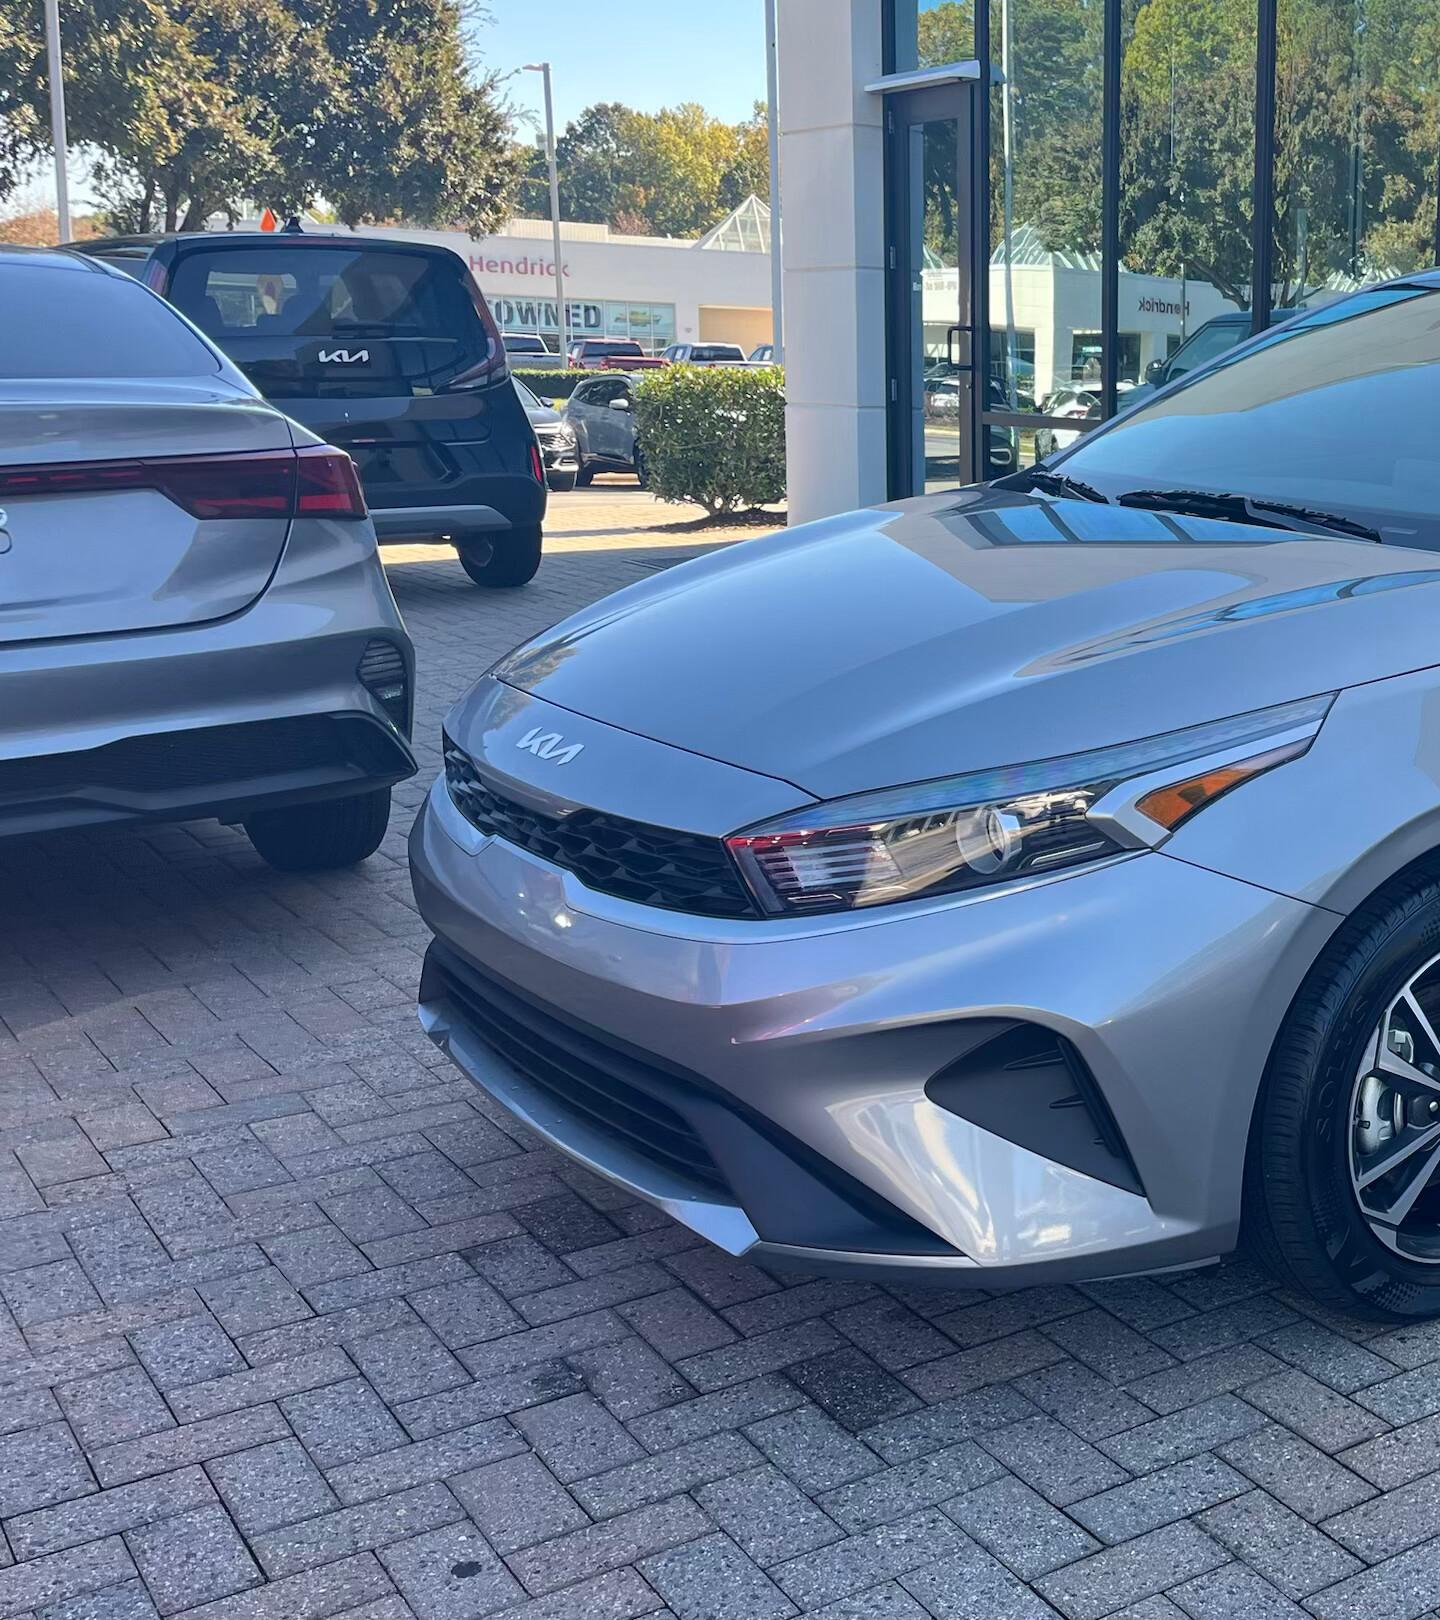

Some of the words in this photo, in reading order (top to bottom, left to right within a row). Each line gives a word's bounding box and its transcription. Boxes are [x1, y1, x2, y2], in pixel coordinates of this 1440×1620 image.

[486, 299, 602, 329] OWNED
[318, 349, 369, 363] KIA
[515, 726, 585, 766] KIA
